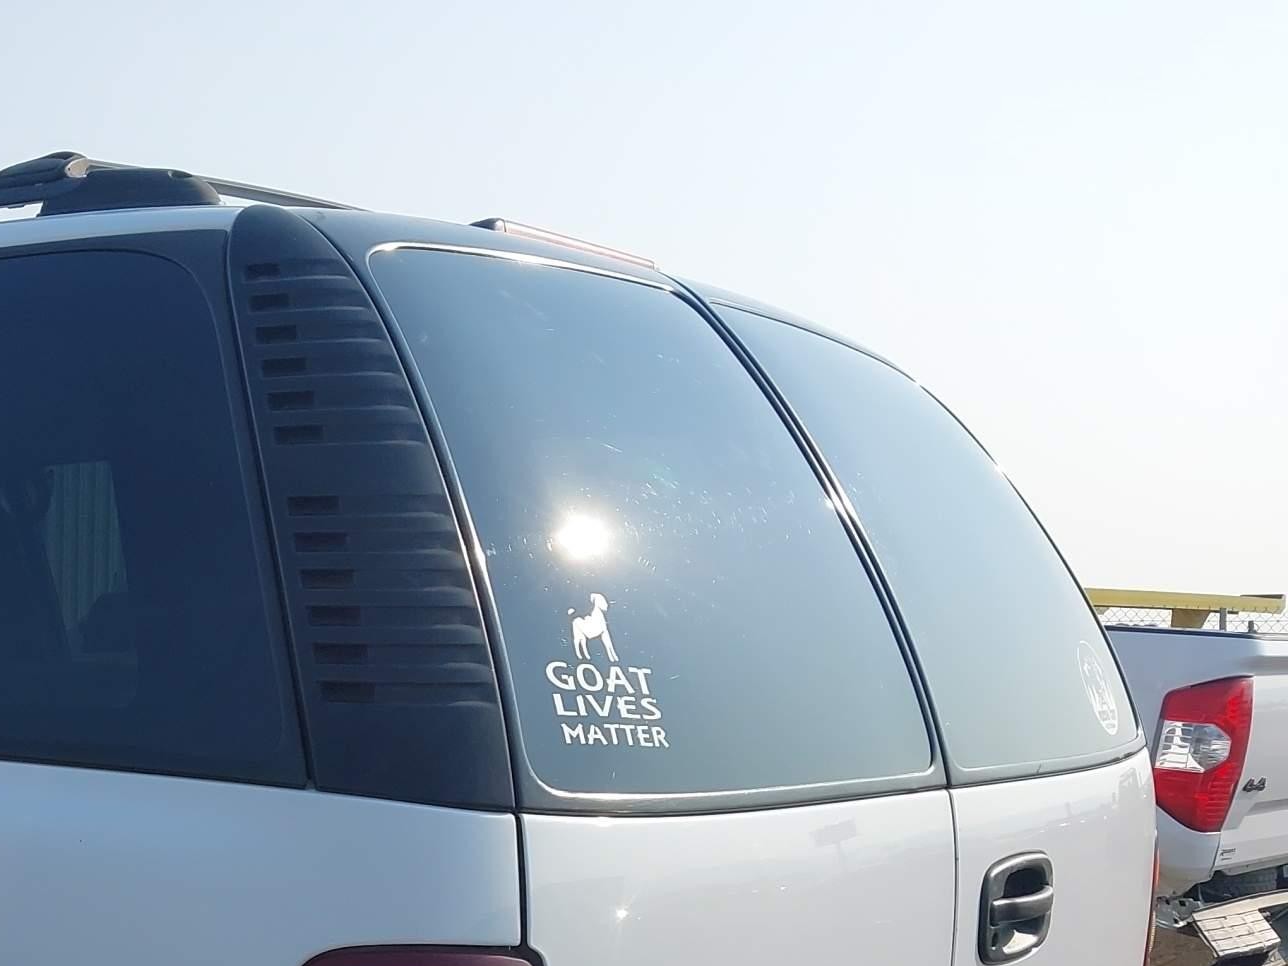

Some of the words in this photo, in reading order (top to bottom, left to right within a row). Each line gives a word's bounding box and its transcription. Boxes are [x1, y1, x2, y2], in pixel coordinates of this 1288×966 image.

[545, 661, 652, 695] GOAT
[552, 693, 662, 720] LIVES
[561, 723, 670, 749] MATTER
